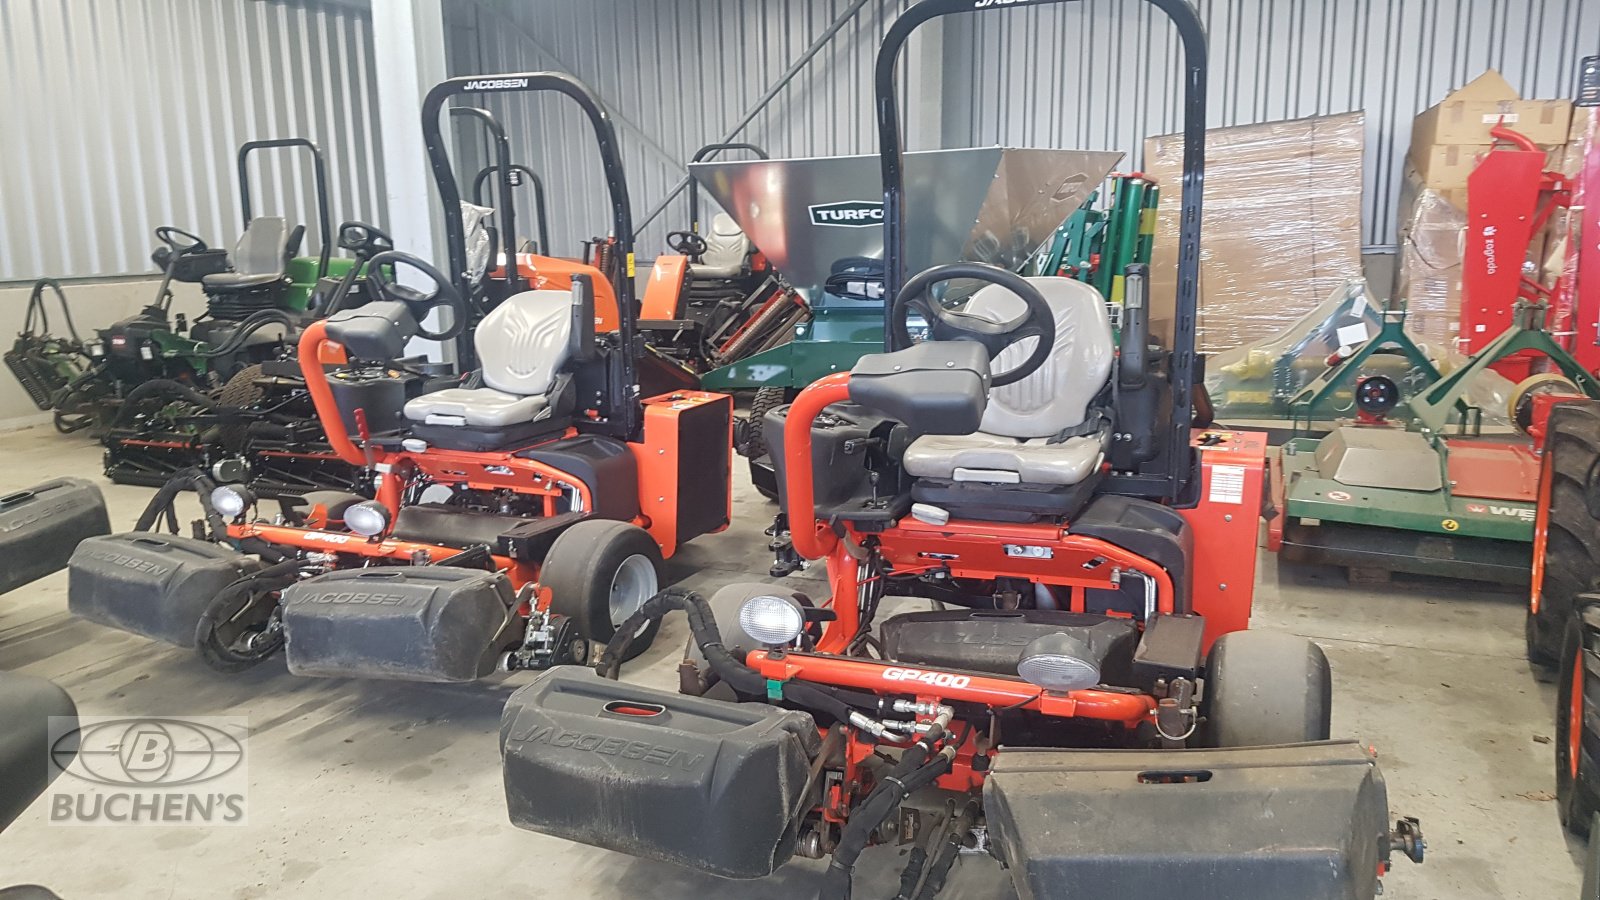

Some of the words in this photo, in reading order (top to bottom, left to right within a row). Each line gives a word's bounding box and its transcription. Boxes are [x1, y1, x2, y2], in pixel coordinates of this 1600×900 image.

[463, 78, 528, 90] JACOBSEN
[882, 667, 971, 689] GP400
[511, 724, 705, 772] JACOBSEN
